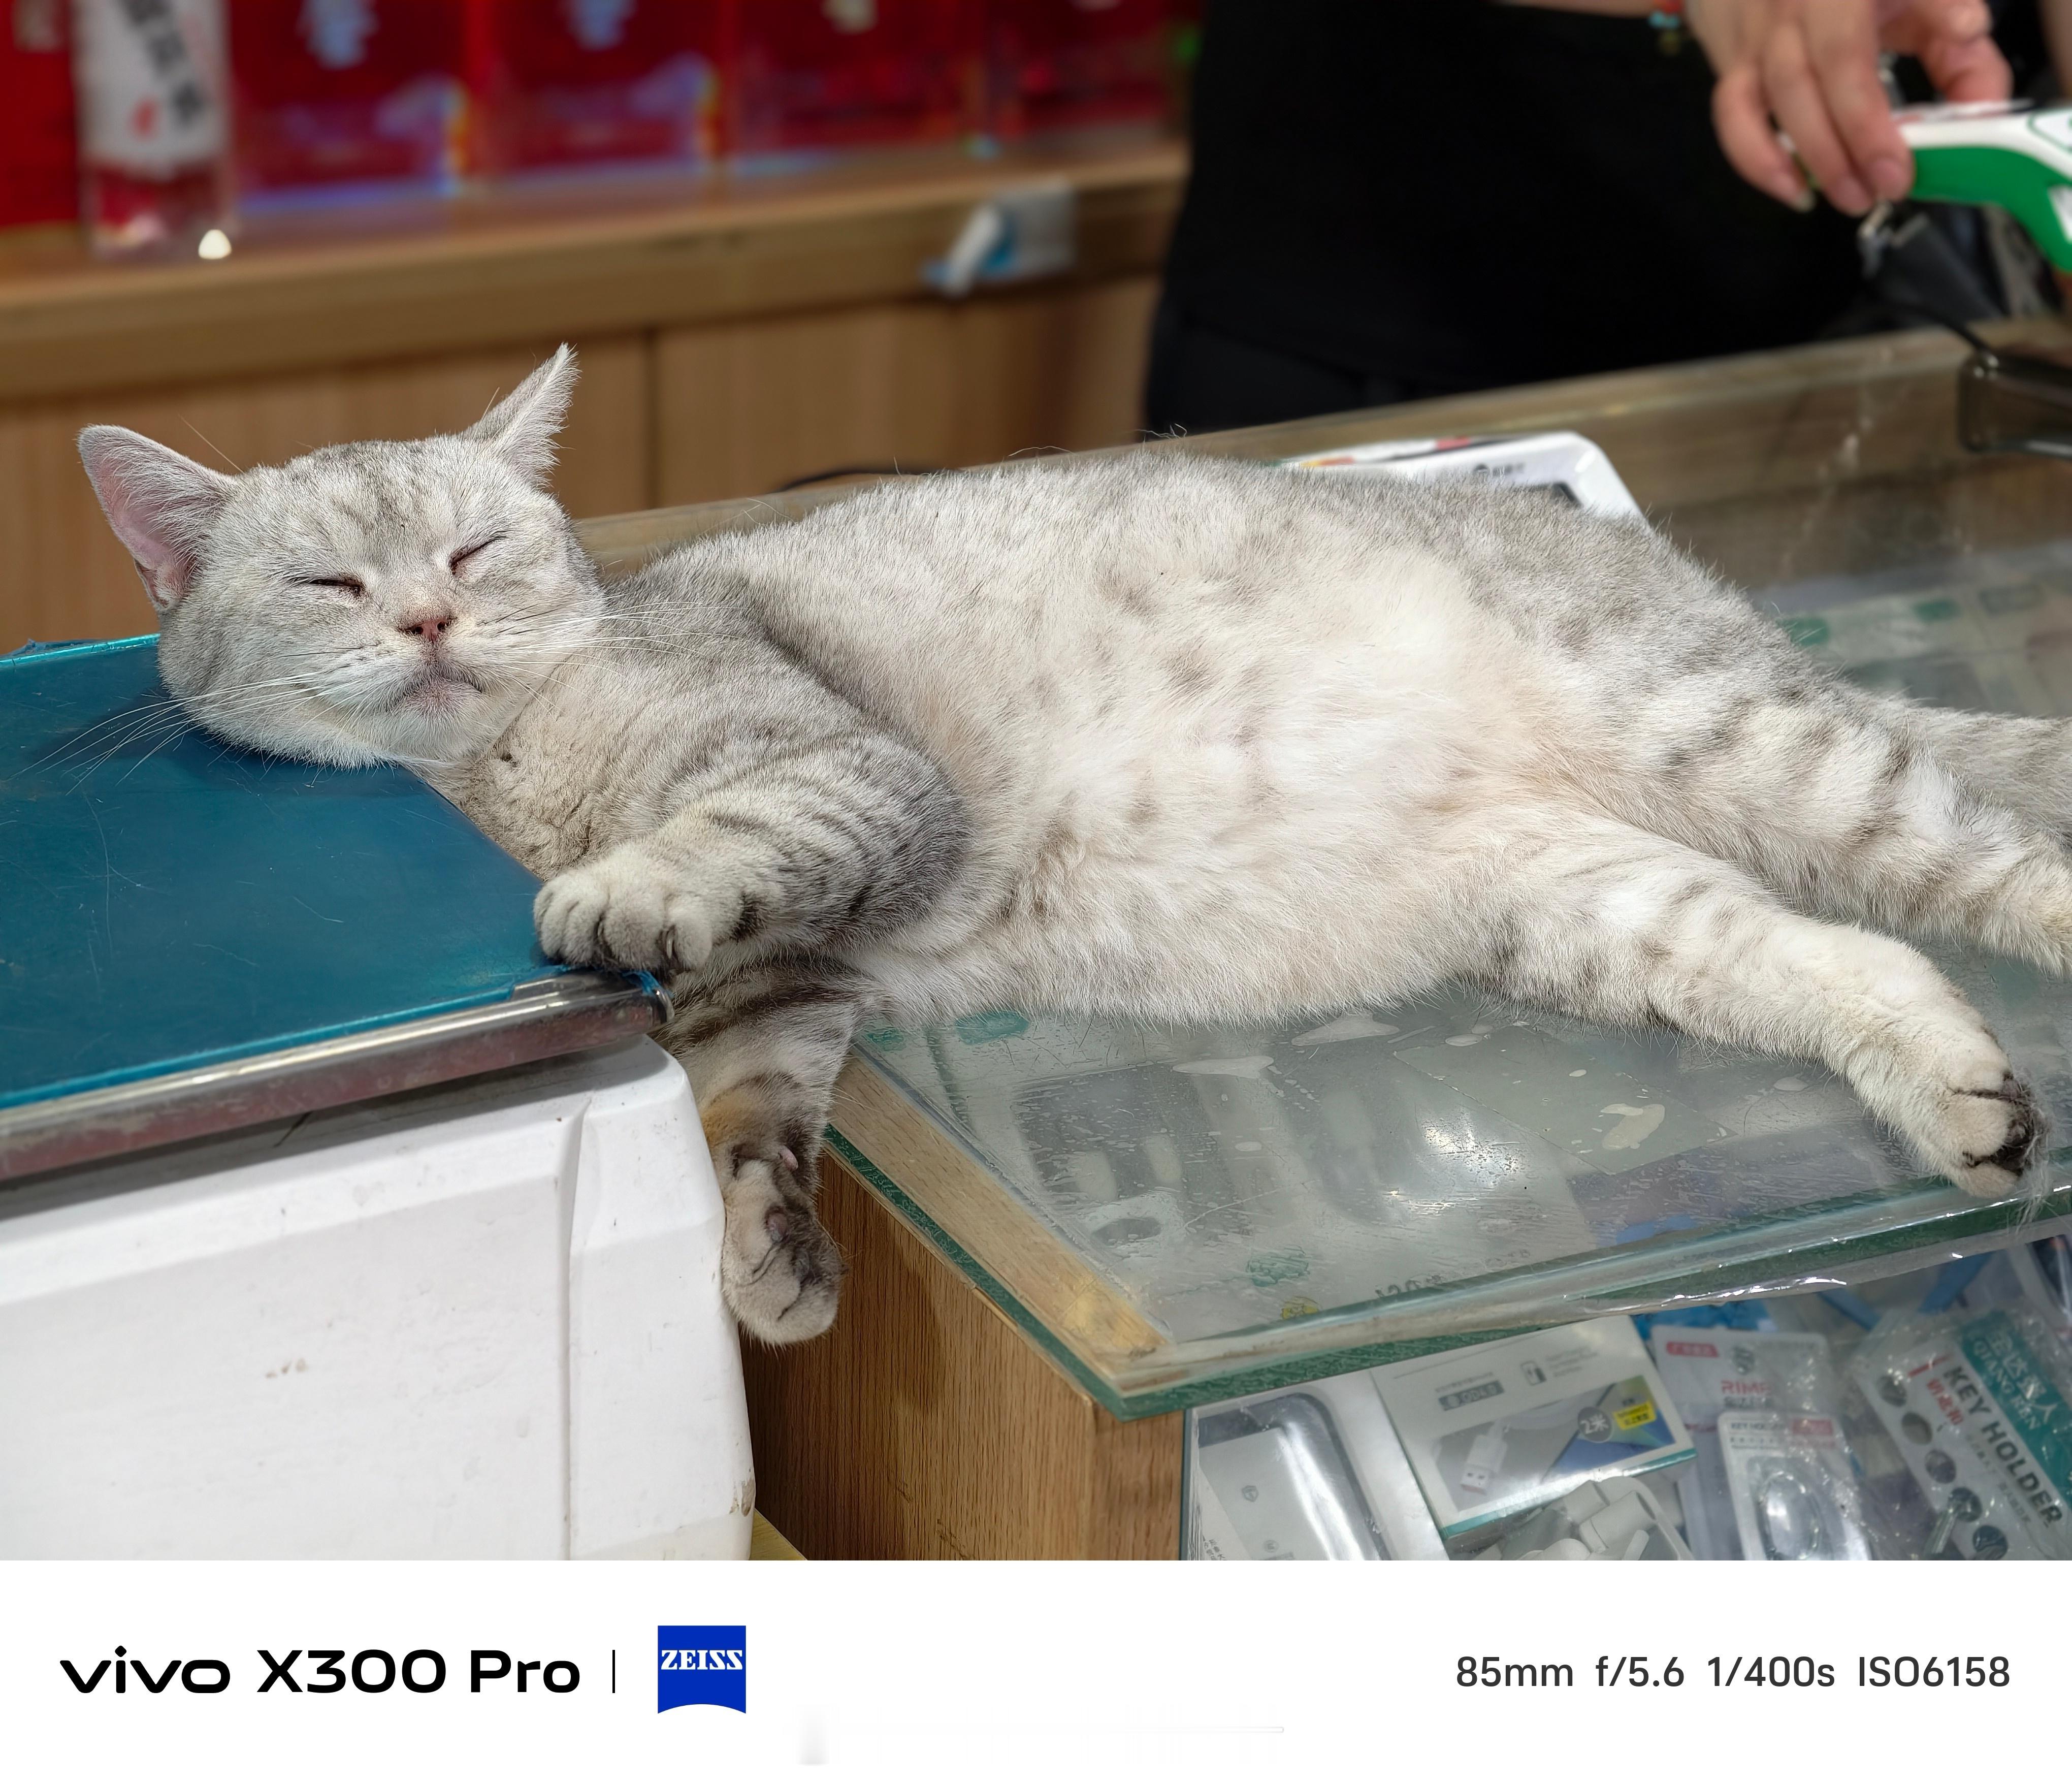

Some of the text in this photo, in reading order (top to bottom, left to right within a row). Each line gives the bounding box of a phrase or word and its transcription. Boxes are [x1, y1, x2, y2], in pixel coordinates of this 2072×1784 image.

[1581, 1412, 1609, 1434] 2米
[1973, 1337, 2015, 1394] QIANG
[2010, 1395, 2036, 1430] REN
[1943, 1366, 1992, 1415] KEY
[1982, 1421, 2062, 1528] HOLDER
